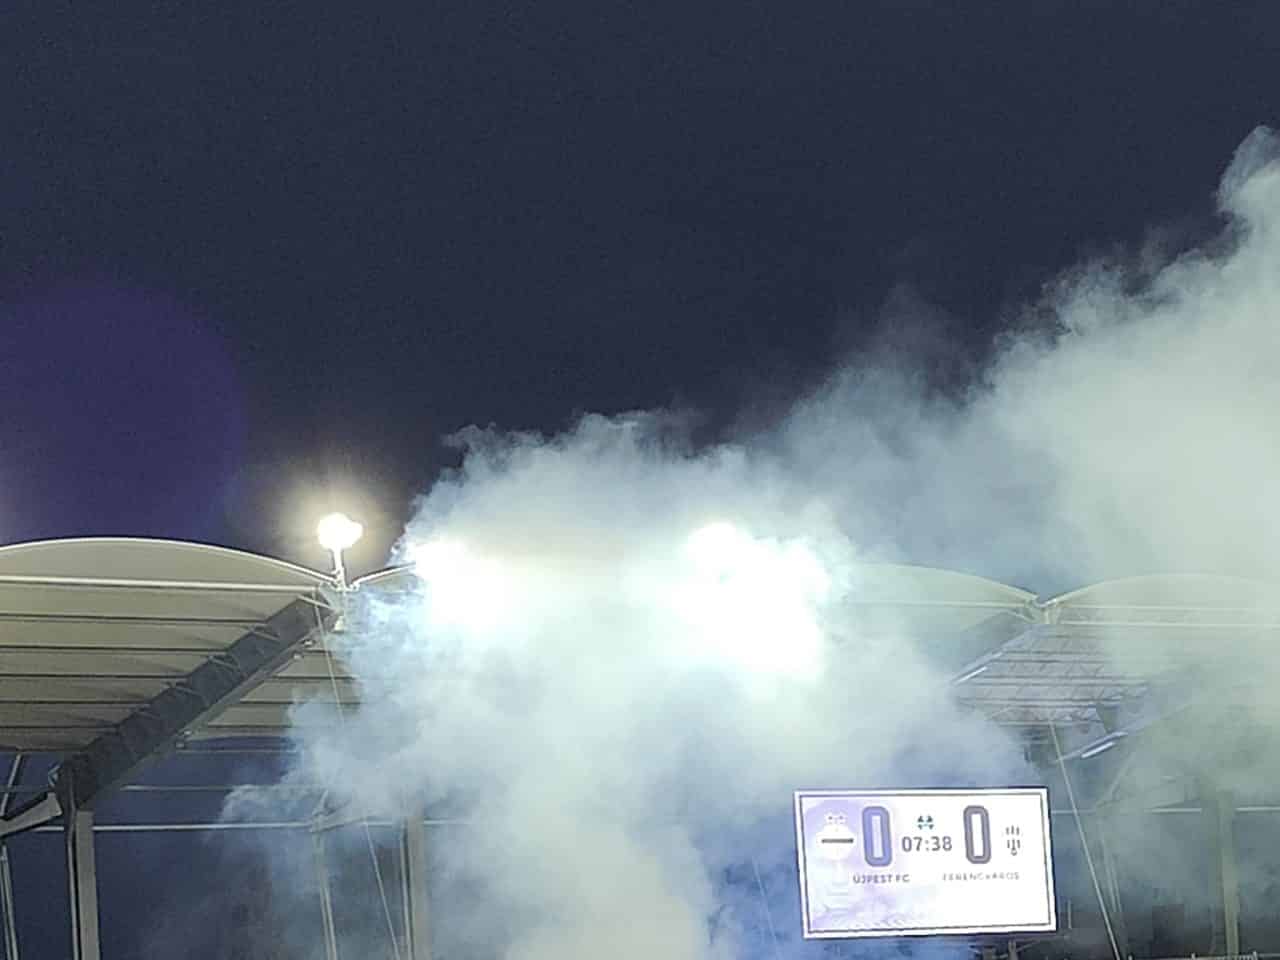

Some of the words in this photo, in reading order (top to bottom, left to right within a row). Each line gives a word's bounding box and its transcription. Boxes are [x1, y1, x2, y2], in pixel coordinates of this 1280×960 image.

[862, 805, 893, 867] 0
[901, 836, 953, 853] 07:38
[963, 804, 992, 865] 0
